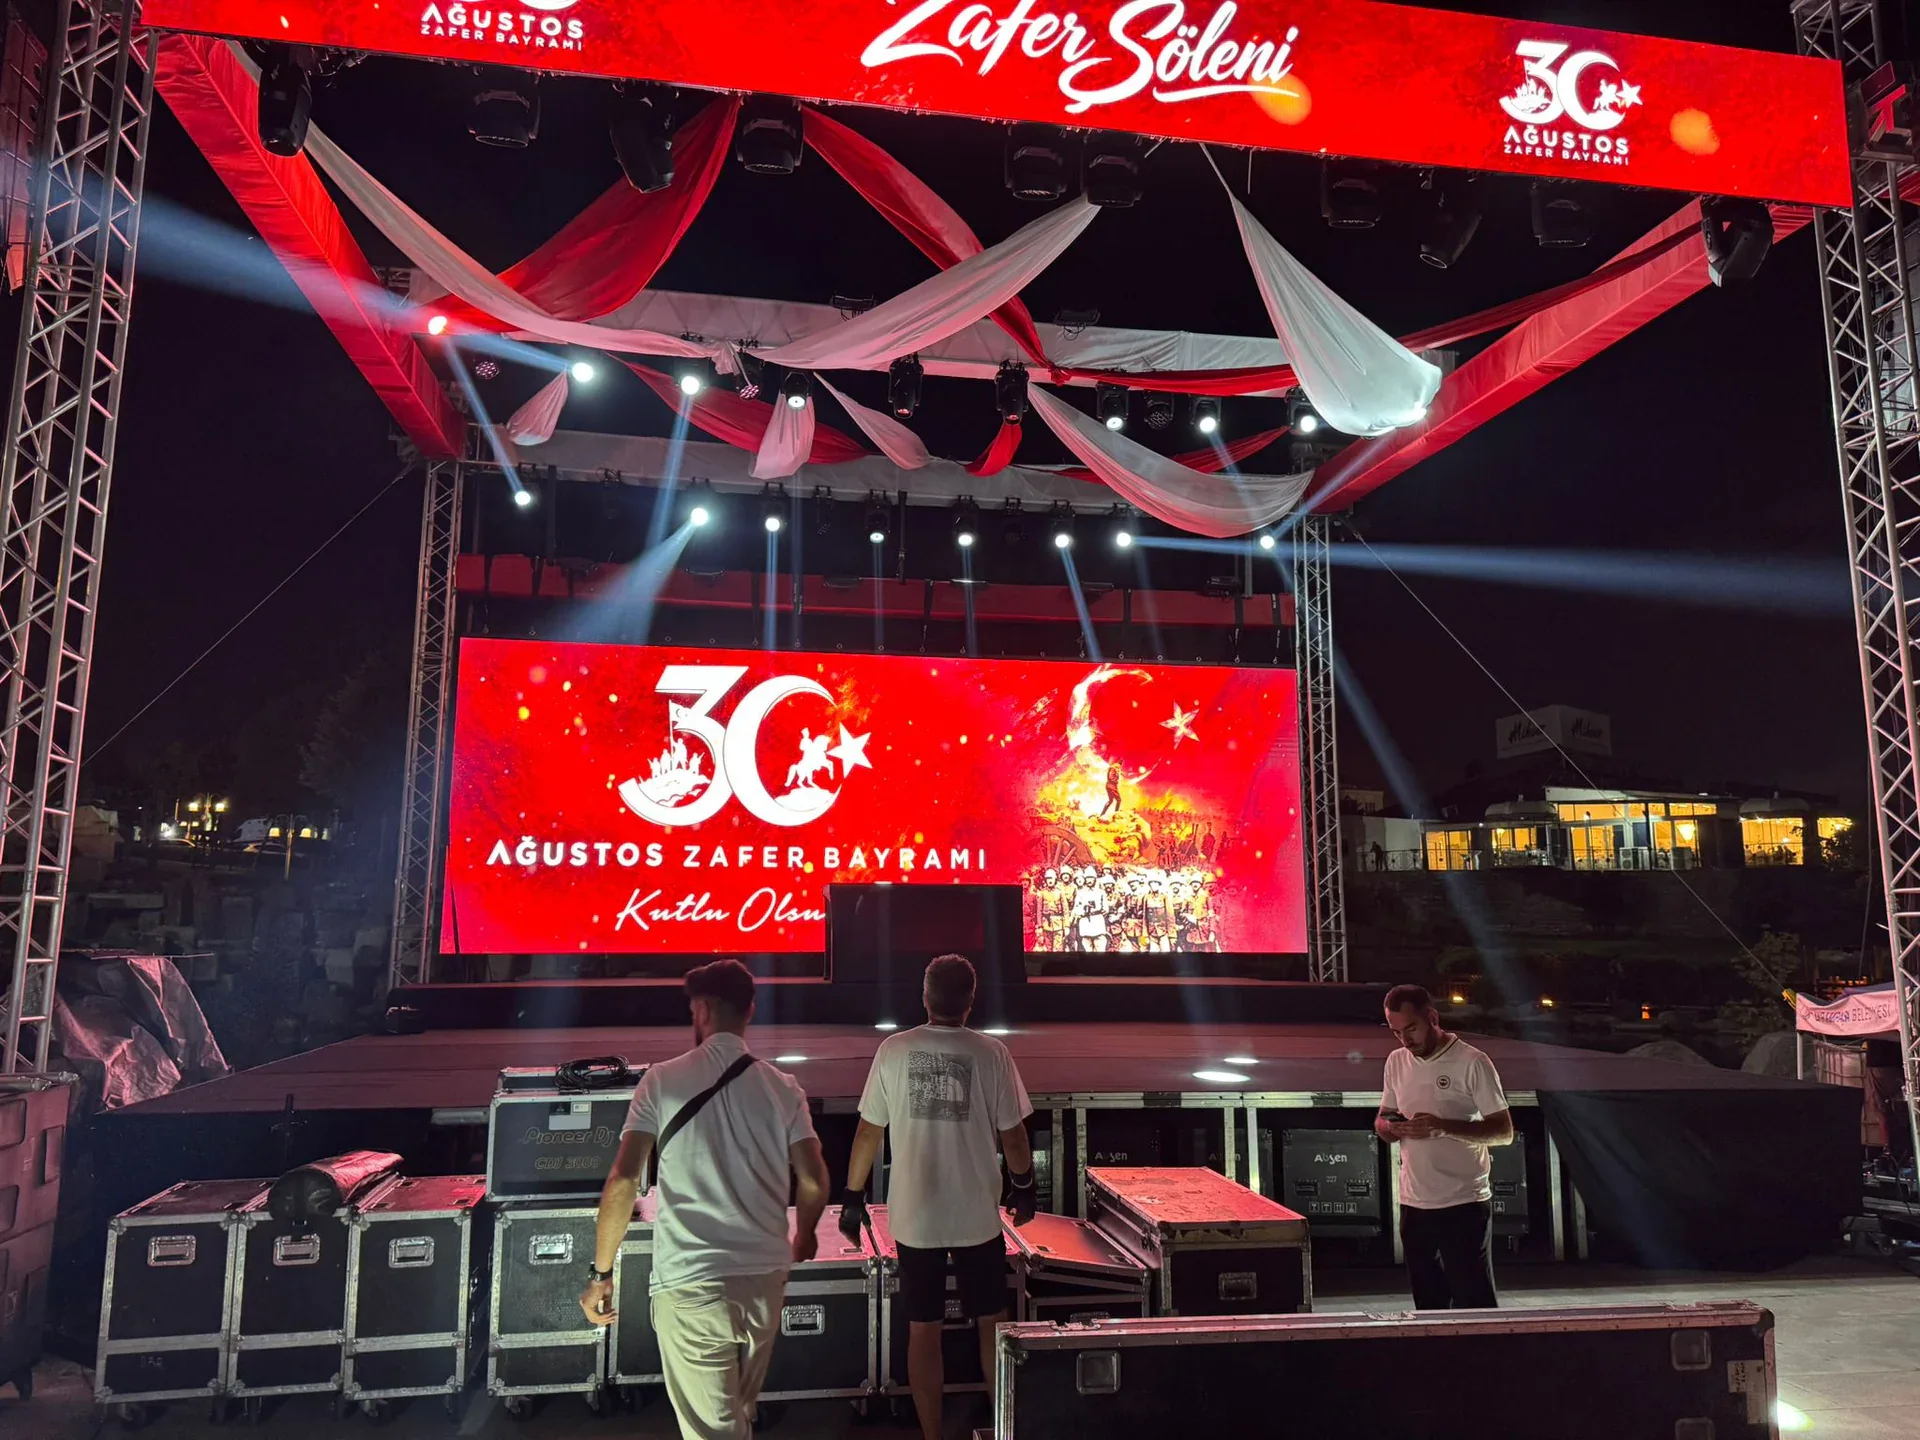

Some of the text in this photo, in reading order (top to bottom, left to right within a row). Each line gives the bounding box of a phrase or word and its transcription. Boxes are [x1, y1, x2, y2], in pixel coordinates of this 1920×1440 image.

[420, 2, 584, 39] AĞUSTOS
[420, 24, 583, 52] ZAFER BAYRAMI
[860, 0, 1096, 76] Zafer
[1503, 125, 1630, 155] AĞUSTOS
[1503, 144, 1630, 166] ZAFER BAYRAMI
[485, 835, 986, 870] AĞUSTOS ZAFER BAYRAMI
[614, 886, 827, 932] Kutlu Olsu
[523, 1126, 594, 1145] Pioneer
[1094, 1151, 1128, 1163] Asen
[1313, 1152, 1348, 1165] Absen
